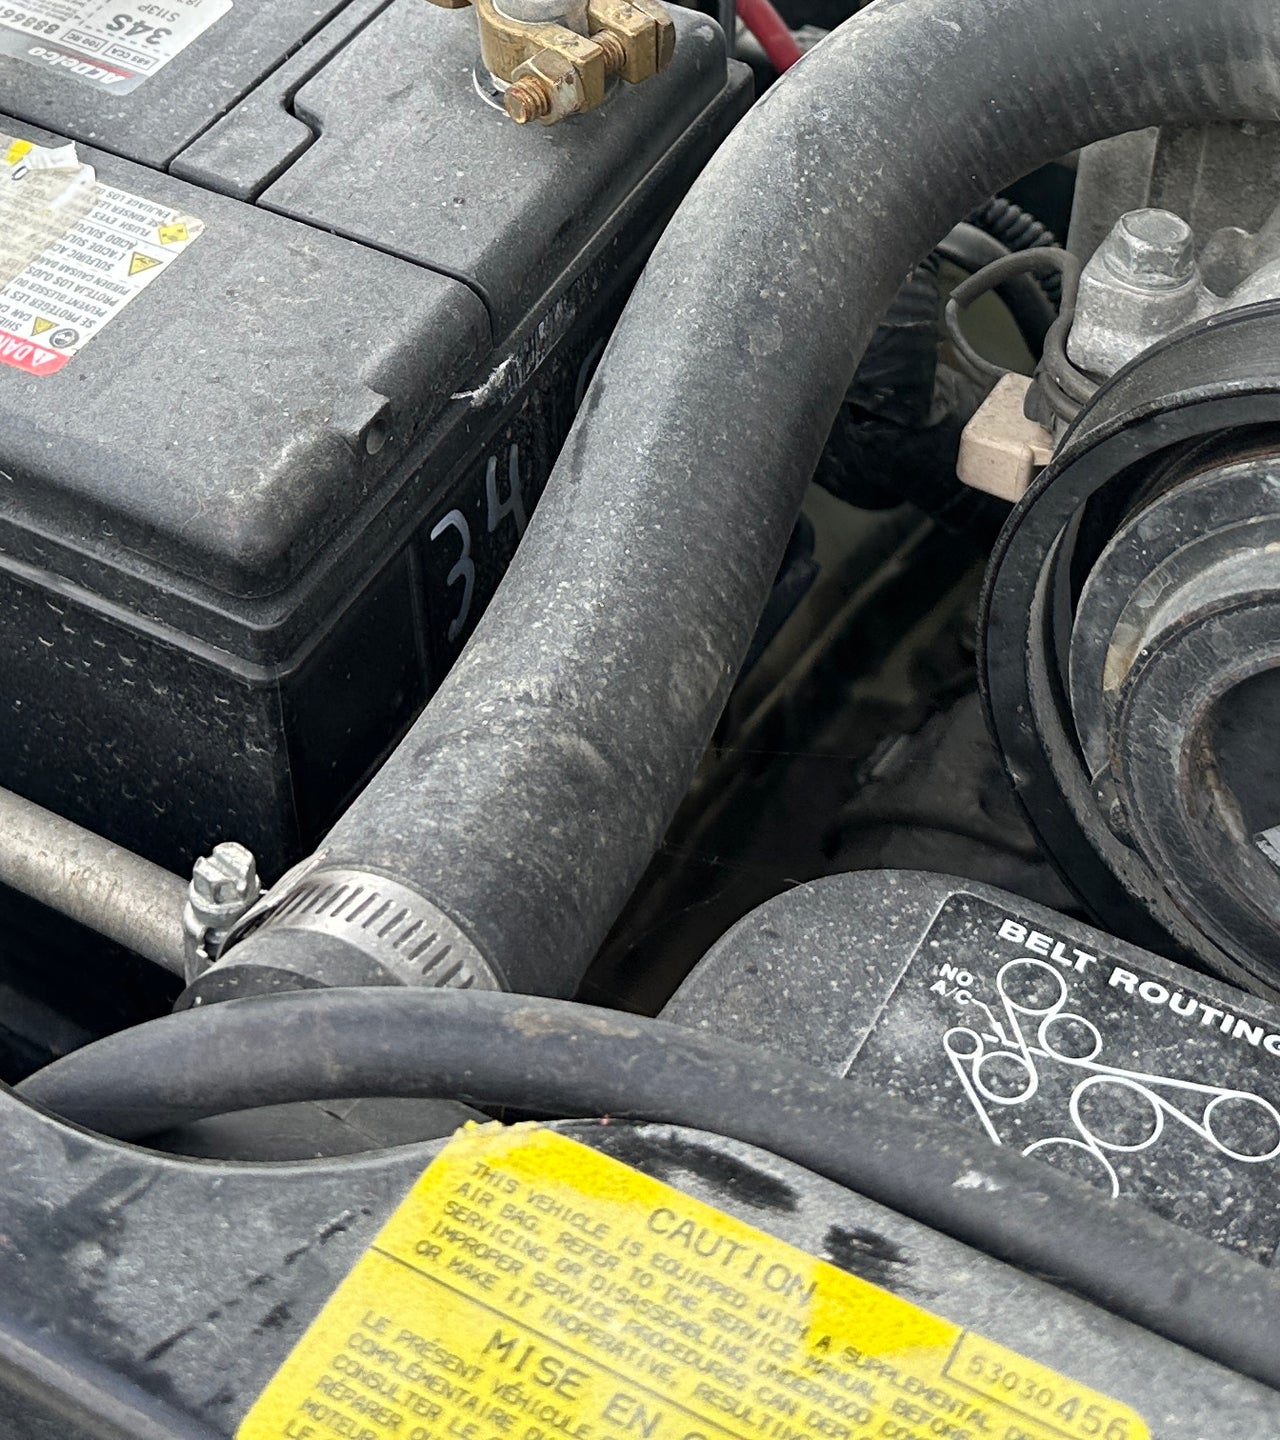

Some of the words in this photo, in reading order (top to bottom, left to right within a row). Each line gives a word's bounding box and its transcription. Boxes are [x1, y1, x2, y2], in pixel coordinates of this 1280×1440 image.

[137, 1, 180, 22] S113P
[105, 12, 172, 46] 34S
[25, 43, 125, 88] ACDelco
[109, 47, 131, 59] CCA
[90, 210, 118, 225] EYES
[56, 263, 95, 282] CAUSAR
[66, 248, 115, 272] SULFURIC
[9, 289, 31, 303] LES
[51, 275, 75, 289] LOS
[72, 283, 120, 307] PROTEJA
[92, 276, 131, 296] PUEDEN
[10, 308, 33, 322] CAN
[64, 296, 108, 317] PEUVENT
[78, 316, 96, 328] SE
[997, 918, 1098, 973] BELT
[938, 962, 974, 987] NO
[929, 980, 973, 1007] A/C
[642, 1203, 820, 1307] CAUTION
[411, 1237, 443, 1263] OR
[445, 1255, 502, 1292] MAKE
[505, 1286, 534, 1310] IT
[440, 1199, 552, 1264] SERVICING
[553, 1254, 584, 1279] OR
[586, 1274, 752, 1365] DISASSEMBLING
[452, 1179, 495, 1209] AIR
[553, 1229, 621, 1272] REFER
[626, 1266, 658, 1291] TO
[660, 1283, 702, 1314] THE
[705, 1305, 799, 1362] SERVICE
[801, 1353, 886, 1405] MANUAL
[469, 1161, 519, 1195] THIS
[522, 1188, 616, 1244] VEHICLE
[615, 1236, 644, 1260] IS
[647, 1251, 751, 1311] EQUIPPED
[756, 1306, 811, 1343] WITH
[812, 1332, 834, 1354] A
[838, 1344, 1000, 1435] SUPPLEMENTAL
[428, 1220, 525, 1277] IMPROPER
[527, 1270, 620, 1326] SERVICE
[618, 1316, 751, 1392] PROCEDURES
[752, 1384, 801, 1418] CAN
[327, 1352, 445, 1422] CONSULTER
[339, 1329, 522, 1433] COMPLÉMENTAIRE
[358, 1309, 392, 1337] LE
[391, 1322, 489, 1385] PRÉSENT
[487, 1371, 598, 1440] VÉHICULE
[478, 1328, 594, 1404] MISE
[600, 1390, 663, 1440] EN
[312, 1371, 408, 1431] RÉPARER
